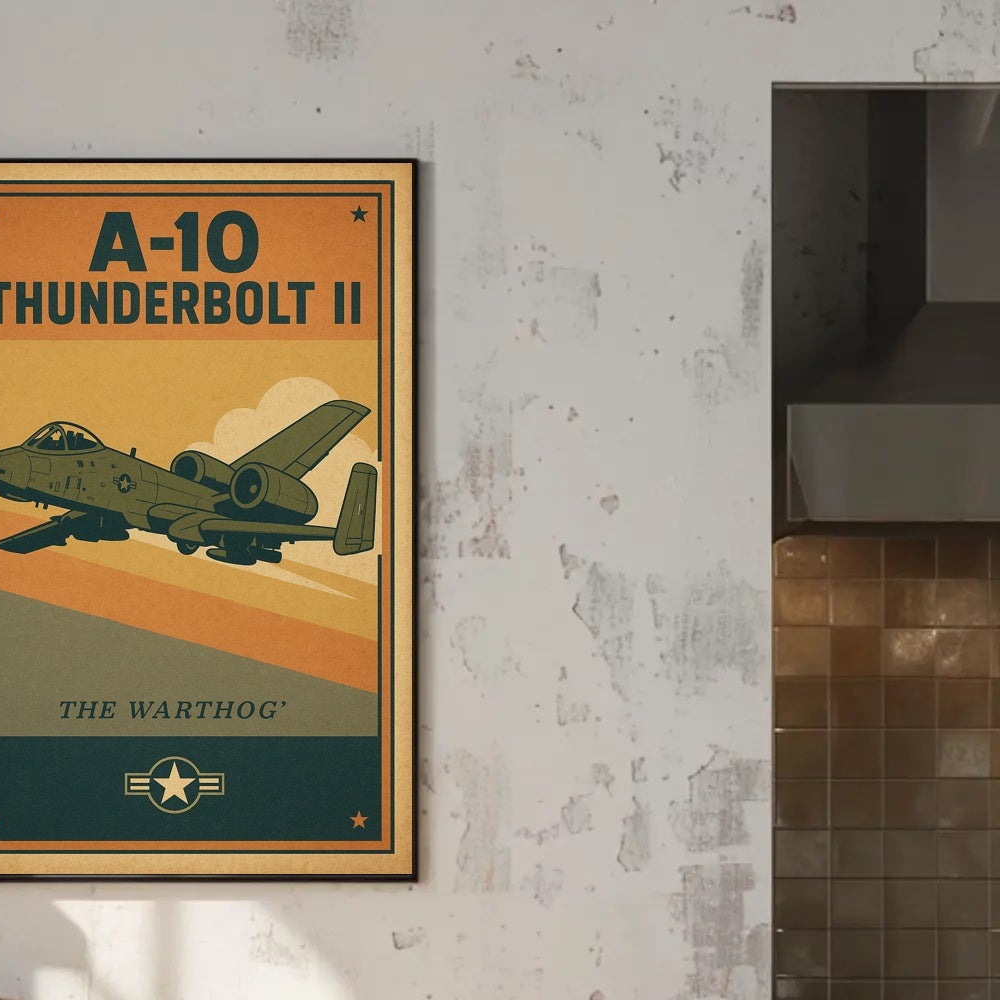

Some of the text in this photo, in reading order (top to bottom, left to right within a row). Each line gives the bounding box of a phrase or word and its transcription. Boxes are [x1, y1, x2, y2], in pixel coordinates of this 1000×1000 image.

[88, 211, 259, 273] A-10
[334, 281, 361, 324] II
[59, 701, 117, 719] THE
